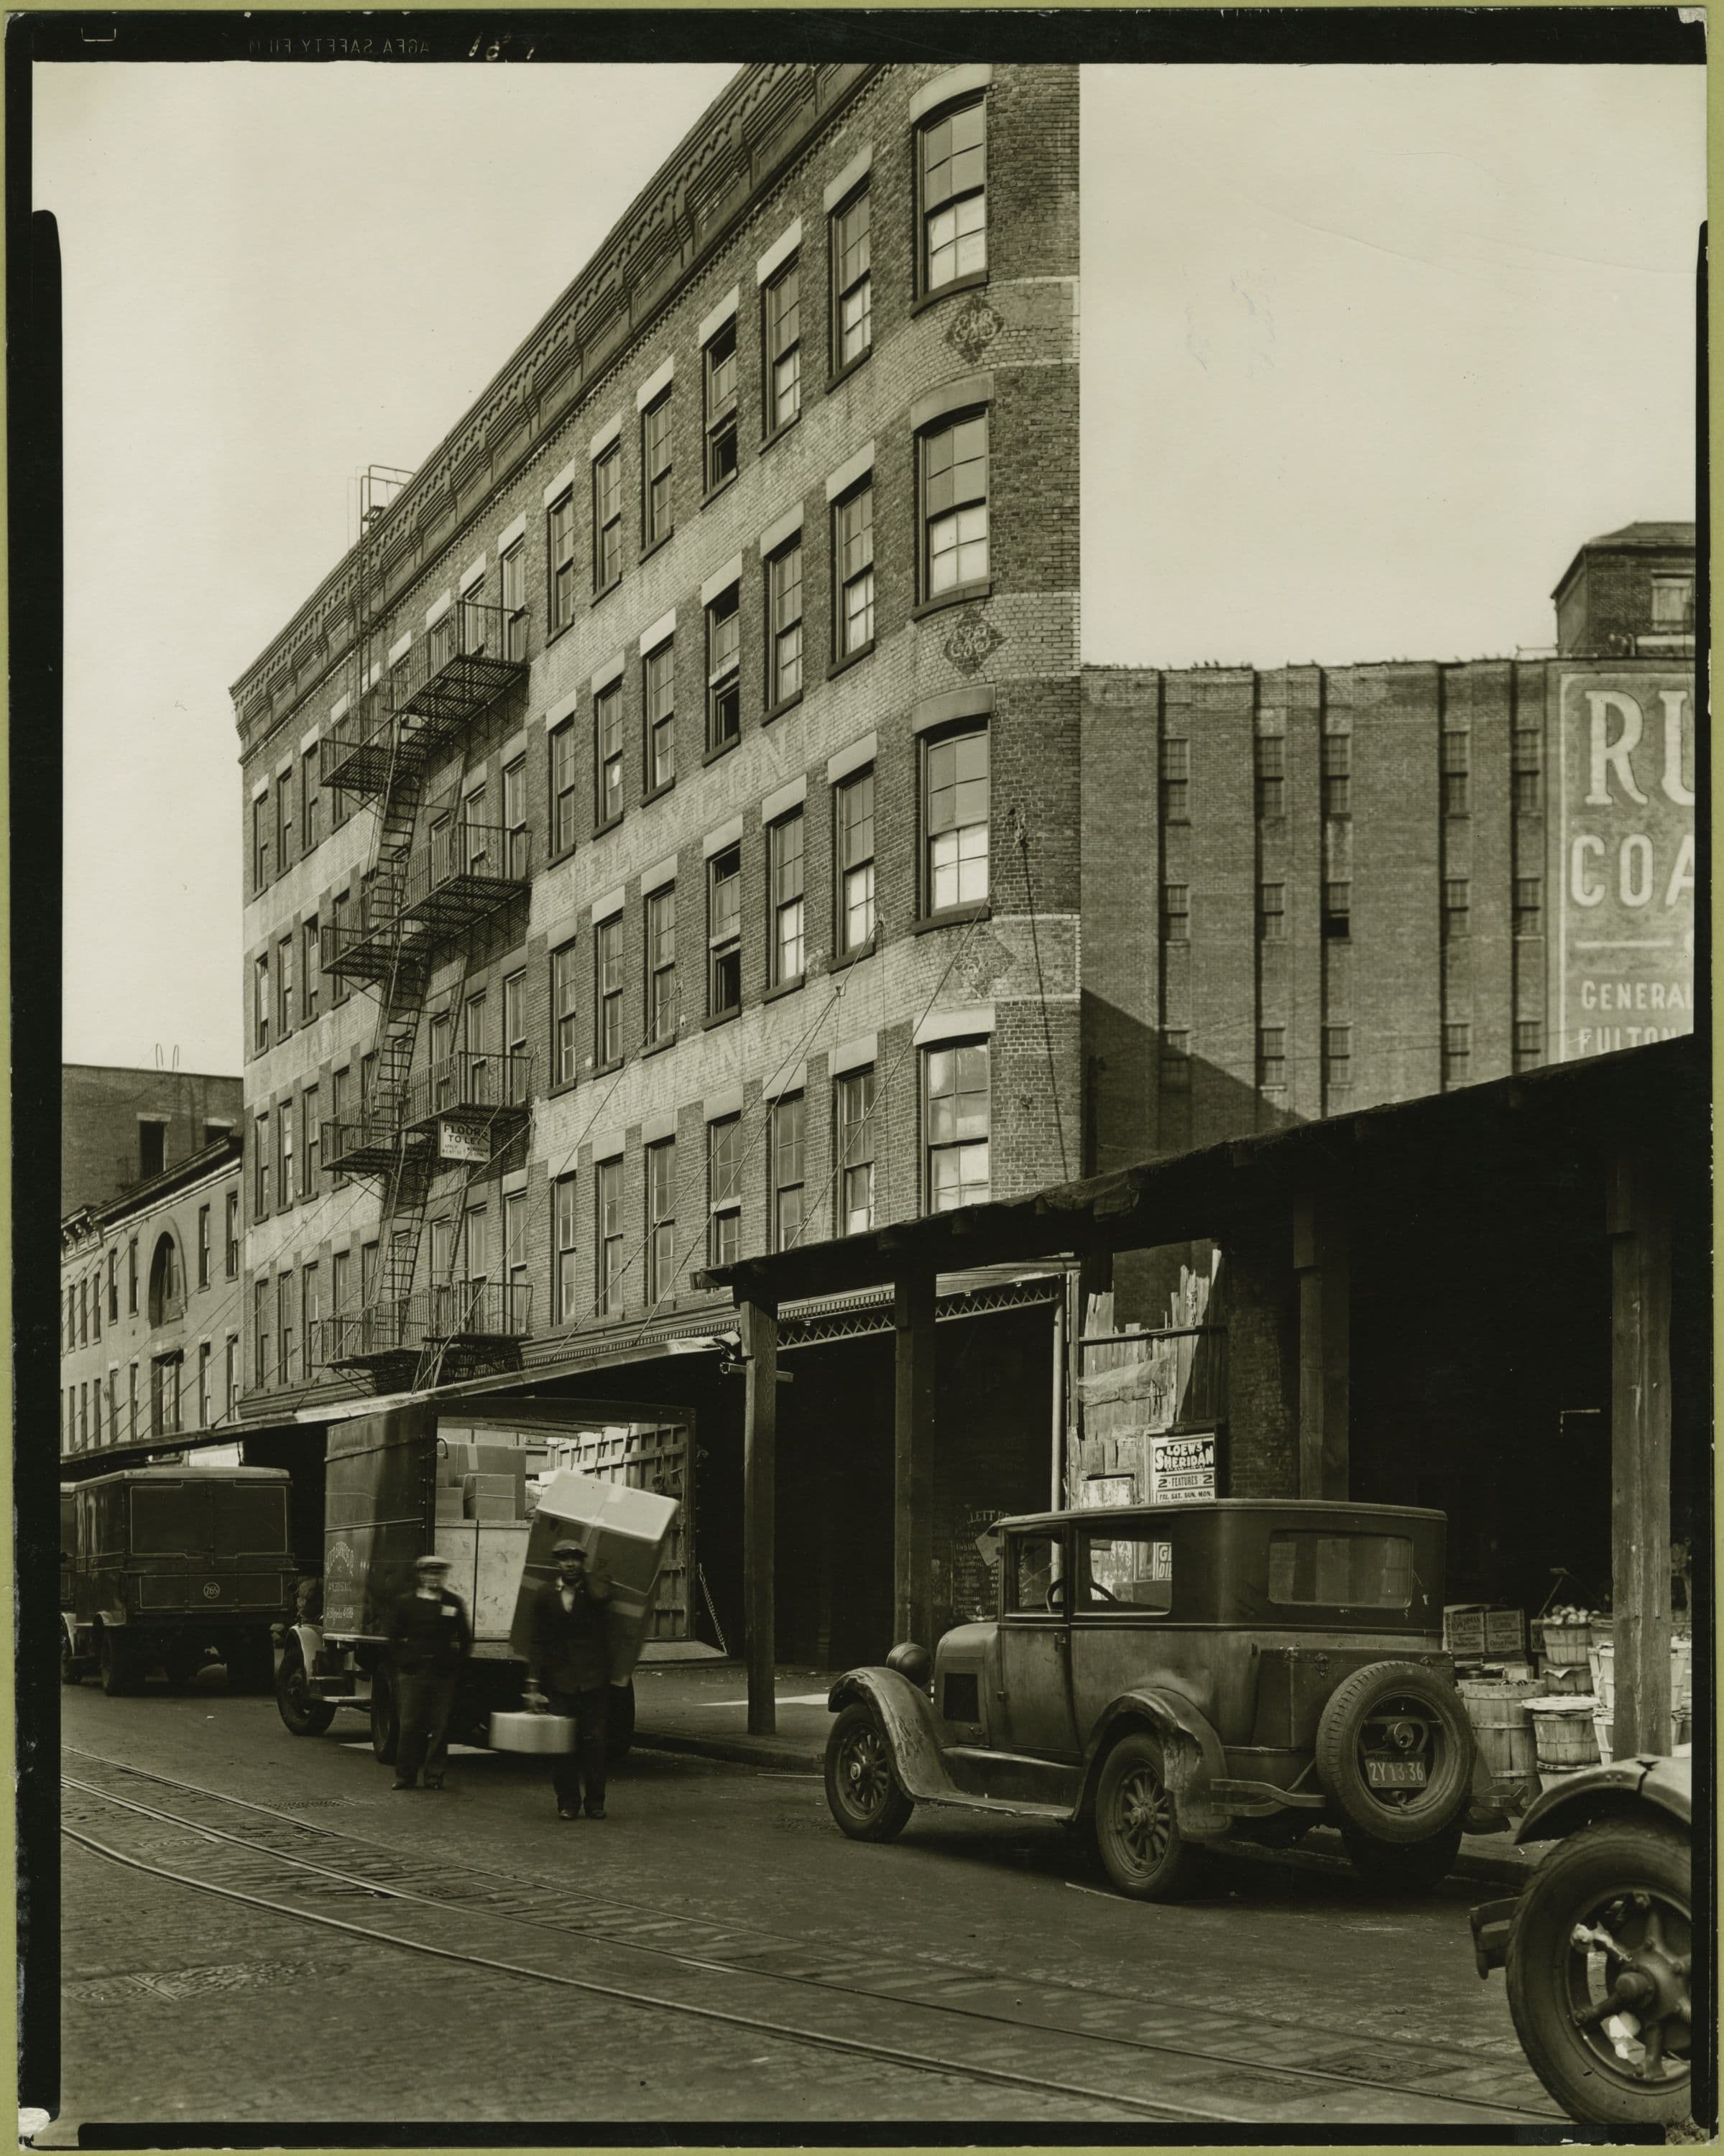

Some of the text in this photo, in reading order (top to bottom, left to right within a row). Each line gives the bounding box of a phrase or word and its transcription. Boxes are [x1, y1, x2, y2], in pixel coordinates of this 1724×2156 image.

[444, 1124, 487, 1139] FLOORS
[448, 1134, 480, 1145] TO LET
[1156, 1445, 1214, 1470] SHERIDAN
[1158, 1473, 1214, 1489] 2 FEATURES 2
